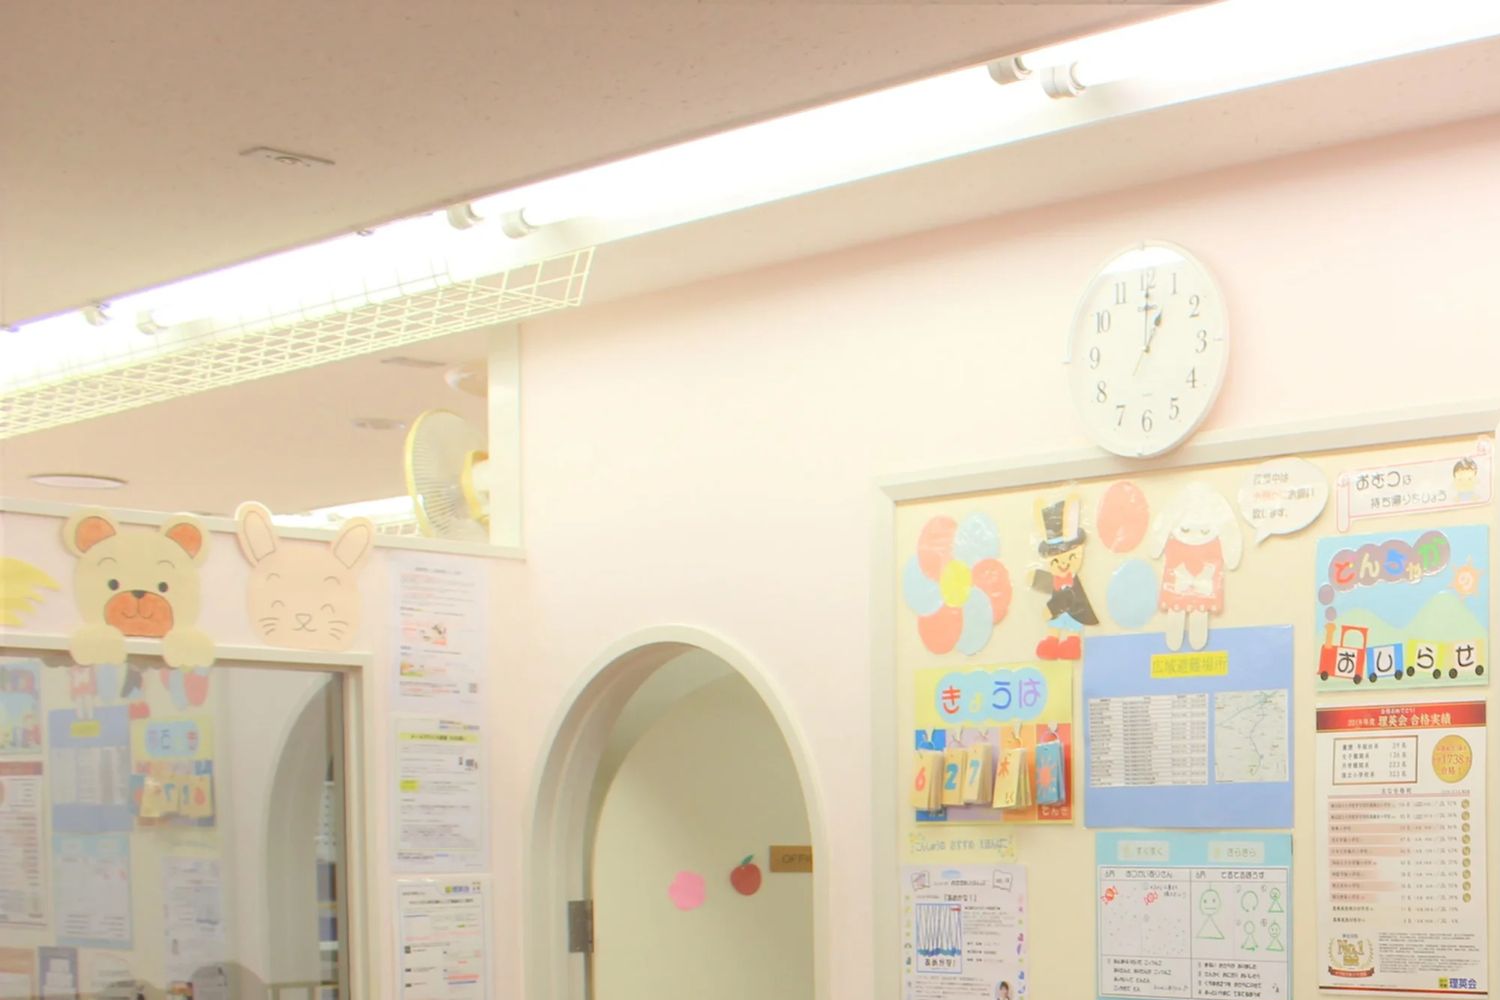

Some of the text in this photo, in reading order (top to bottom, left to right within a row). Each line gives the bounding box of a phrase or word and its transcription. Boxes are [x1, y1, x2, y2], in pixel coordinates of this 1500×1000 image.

[1140, 266, 1157, 292] 12
[1171, 272, 1178, 296] 1
[1115, 281, 1126, 305] 11
[1188, 294, 1200, 319] 2
[1096, 309, 1111, 334] 10
[1195, 329, 1207, 354] 3
[1089, 346, 1101, 370] 9
[1186, 366, 1198, 389] 4
[1096, 380, 1108, 404] 8
[1115, 403, 1127, 427] 7
[1169, 396, 1179, 421] 5
[1141, 409, 1153, 434] 6
[1152, 656, 1228, 676] 広域避難場所
[1337, 644, 1476, 675] おしらせ
[940, 678, 1041, 715] きょうは
[1378, 711, 1452, 727] 理英会 合格実績
[915, 767, 926, 792] 6
[944, 763, 959, 791] 2
[969, 760, 980, 786] 7
[1136, 846, 1163, 857] すくすく
[1226, 847, 1257, 859] きらきら
[1449, 977, 1478, 990] 理英会
